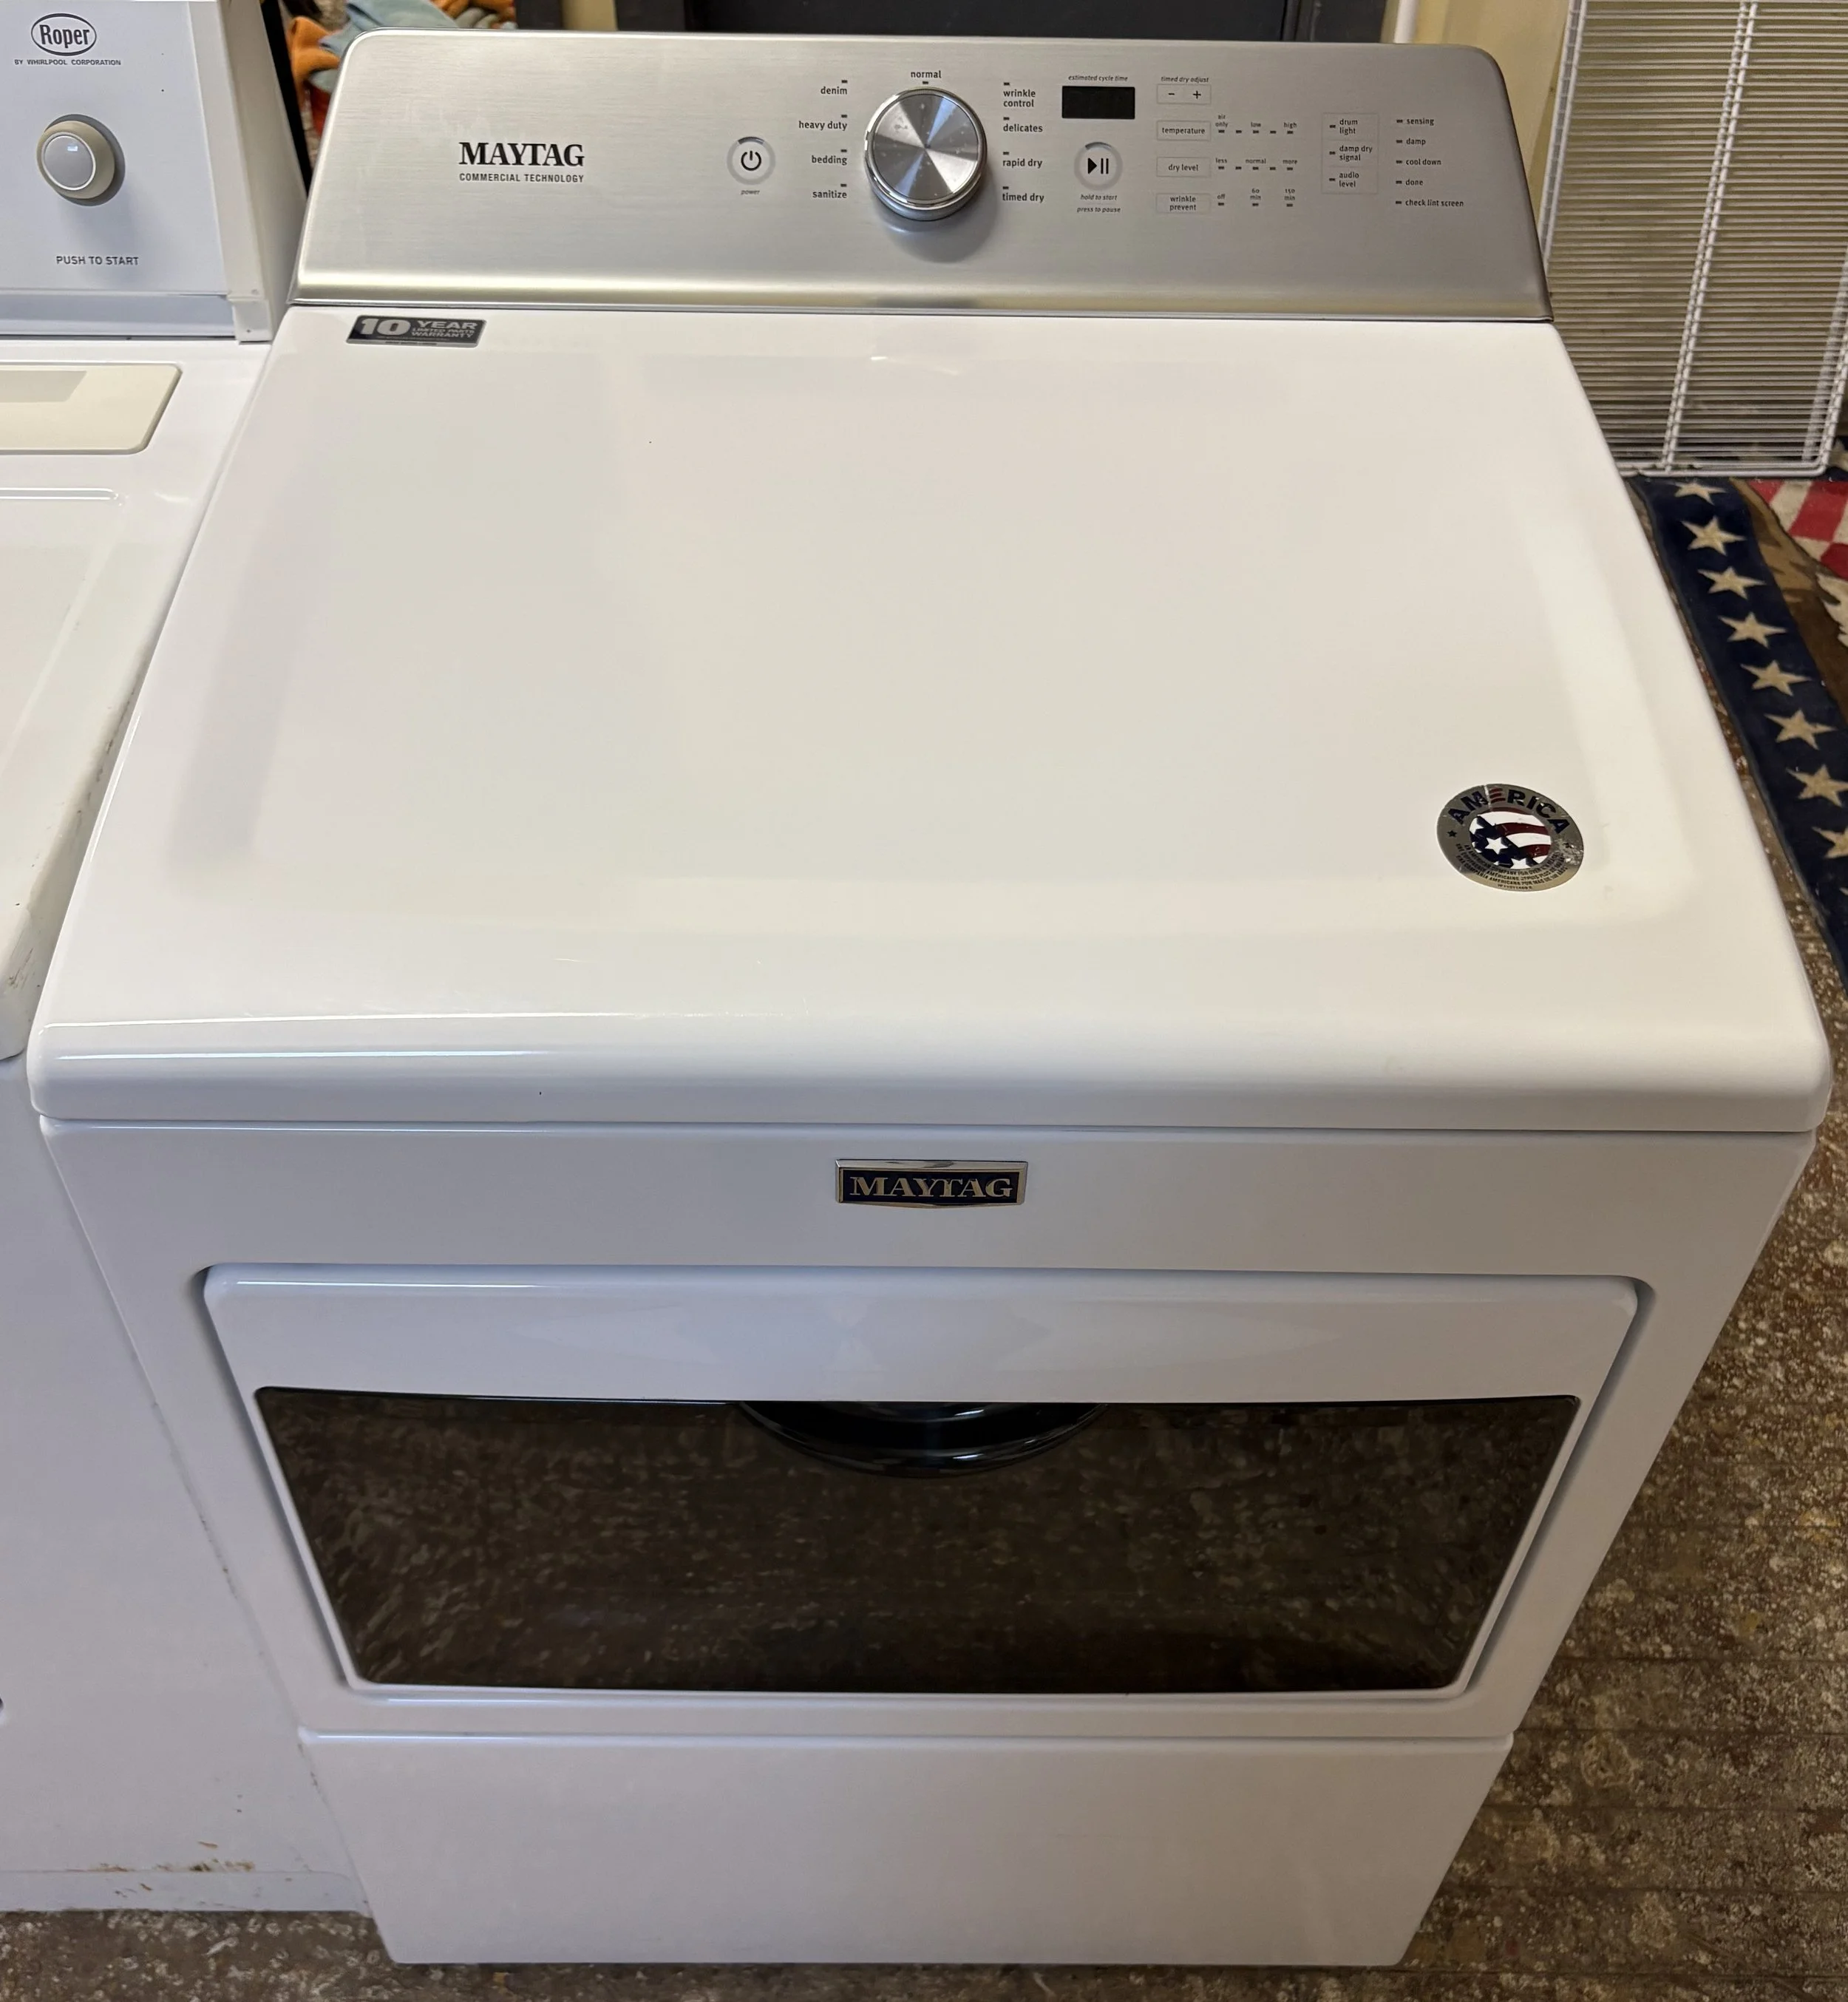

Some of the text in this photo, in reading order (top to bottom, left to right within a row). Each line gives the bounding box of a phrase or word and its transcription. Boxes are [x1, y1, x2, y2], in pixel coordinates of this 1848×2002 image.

[39, 24, 90, 49] Roper
[911, 70, 942, 79] normal
[821, 86, 848, 95] denim
[1003, 89, 1036, 98] wrinkle
[1003, 99, 1035, 108] control
[798, 121, 848, 131] heavy duty
[1406, 118, 1435, 126] sensing
[1003, 123, 1043, 132] delicates
[1161, 127, 1206, 136] temperature
[1339, 127, 1356, 135] light
[1406, 138, 1426, 146] damp
[1339, 145, 1373, 153] damp dry
[458, 141, 585, 167] MAYTAG
[1339, 154, 1361, 162] signal
[812, 155, 848, 166] bedding
[1003, 158, 1043, 169] rapid dry
[1168, 163, 1199, 172] dry level
[459, 173, 584, 183] COMMERCIAL TECHNOLOGY
[1339, 180, 1356, 188] level
[812, 190, 847, 199] sanitize
[1002, 192, 1044, 203] timed dry
[1169, 203, 1197, 211] prevent
[56, 256, 139, 265] PUSH TO START
[361, 318, 412, 336] 10
[417, 320, 478, 330] YEAR
[1447, 787, 1570, 834] AMERICA
[850, 1176, 1013, 1198] MAYTAG
